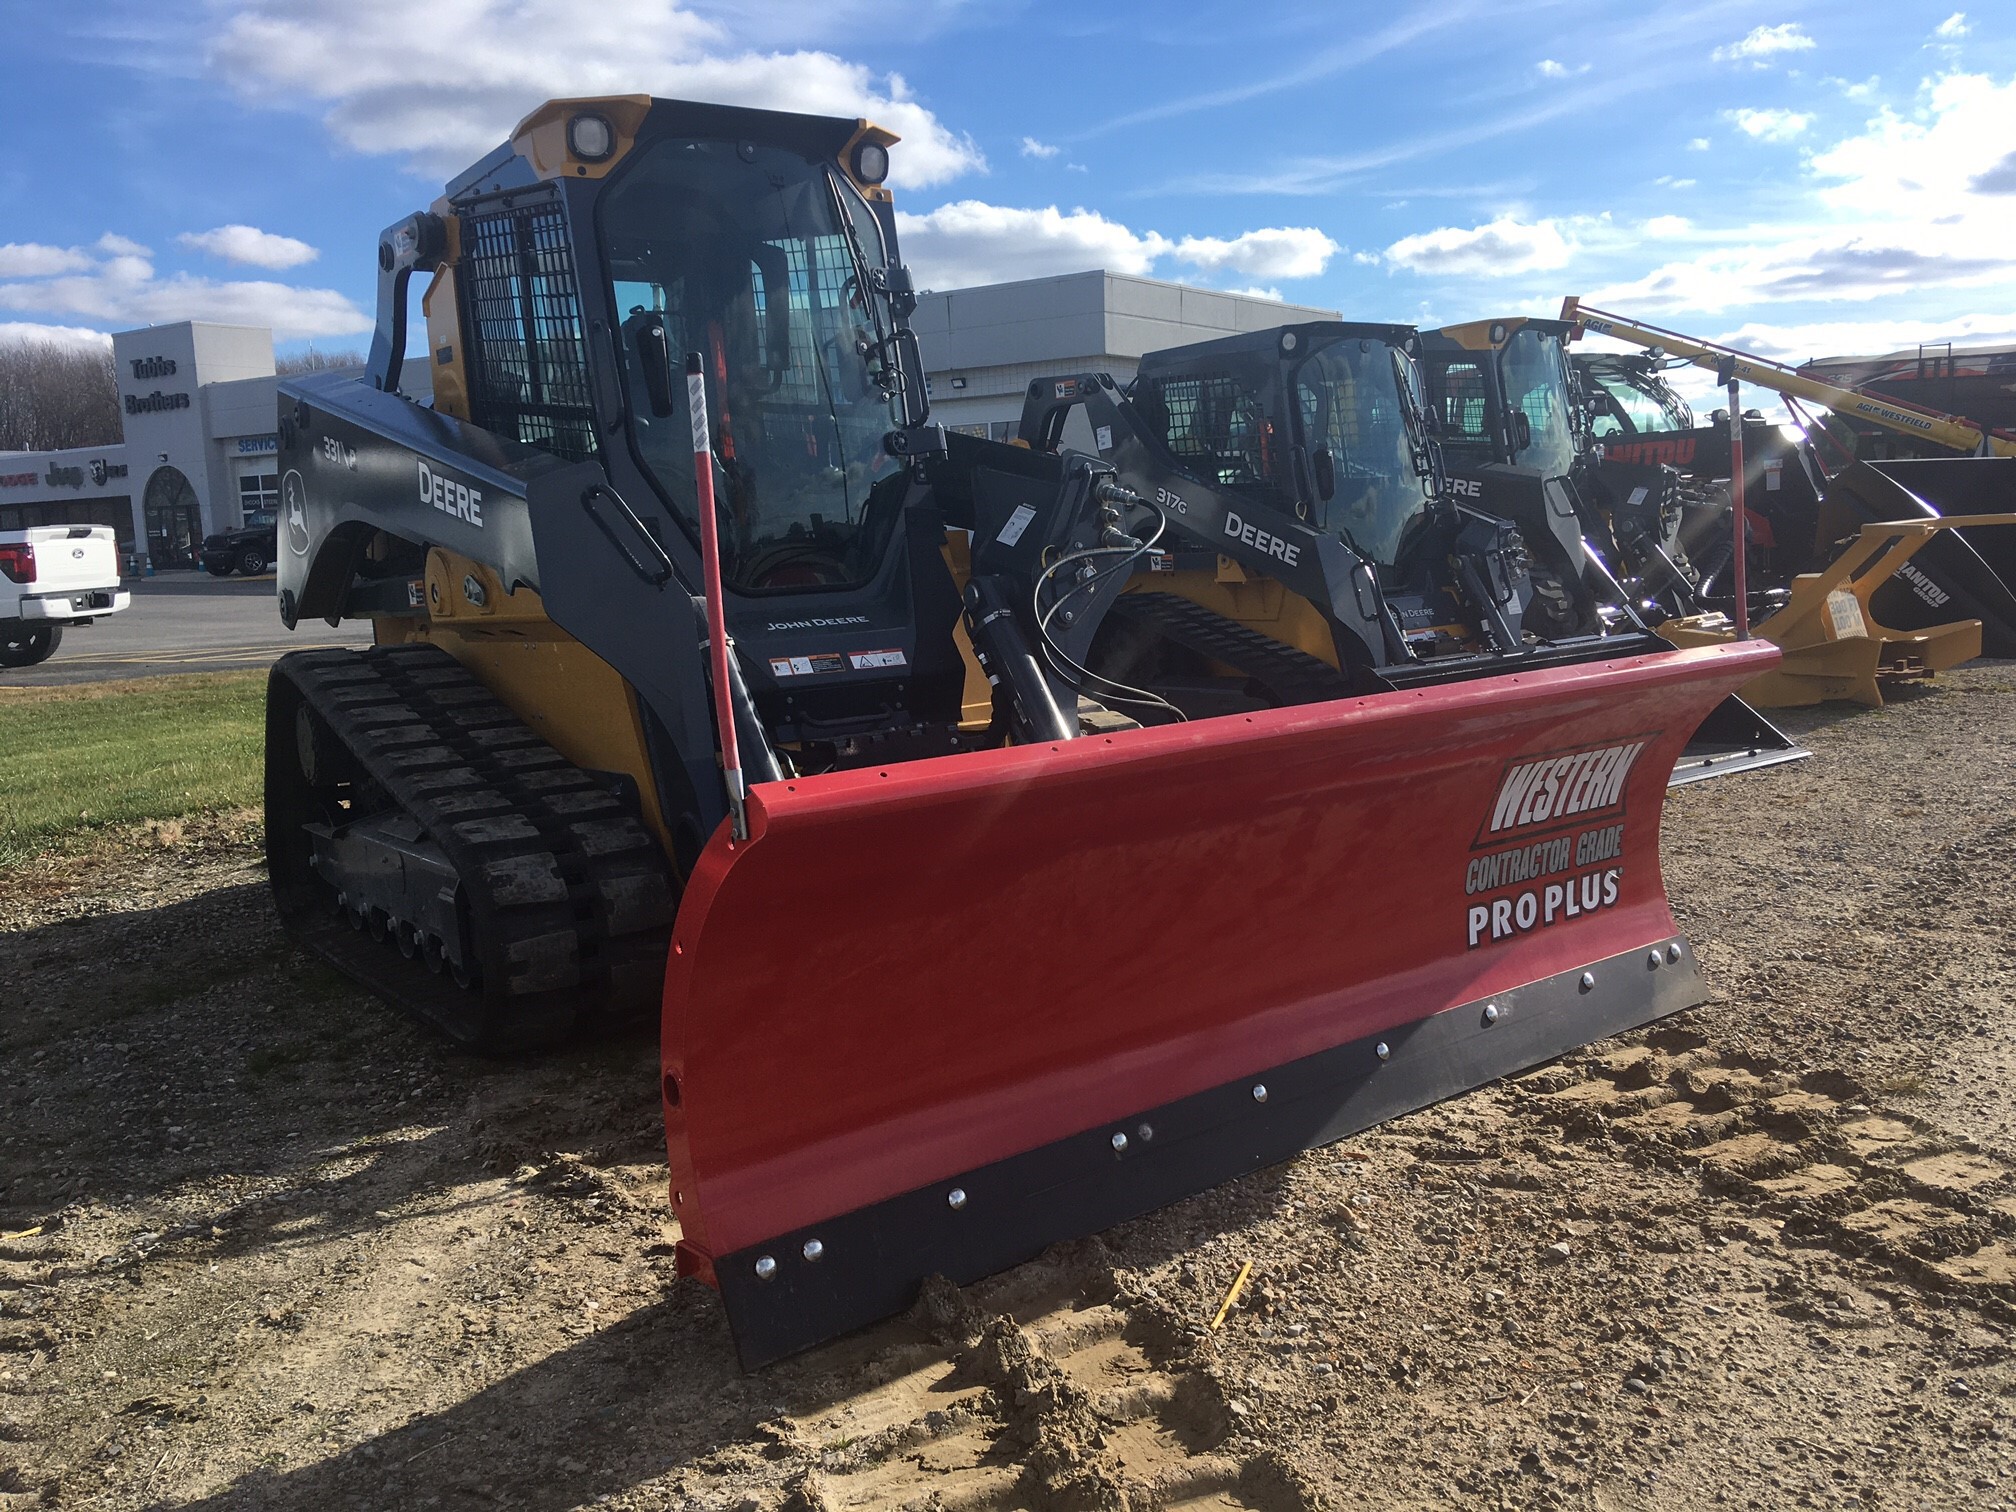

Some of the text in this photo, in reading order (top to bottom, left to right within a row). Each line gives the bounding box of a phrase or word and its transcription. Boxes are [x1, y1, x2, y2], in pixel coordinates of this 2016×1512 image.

[1583, 318, 1603, 332] AGI
[129, 356, 177, 379] Tubbs
[124, 391, 190, 415] Brothers
[1856, 402, 1932, 430] AGI WESTFIELD
[238, 436, 278, 453] SERVIC
[323, 436, 341, 464] 331
[418, 461, 483, 528] DEERE
[1440, 477, 1483, 498] ERE
[1156, 487, 1188, 515] 317G
[1224, 511, 1301, 567] DEERE
[1912, 586, 1940, 608] GROUP
[767, 615, 870, 631] JOHN DEERE
[1408, 608, 1435, 617] DEERE
[1490, 742, 1645, 832] WESTERN
[1465, 824, 1624, 894] CONTRACTOR GRADE
[1469, 868, 1618, 946] PRO PLUS
